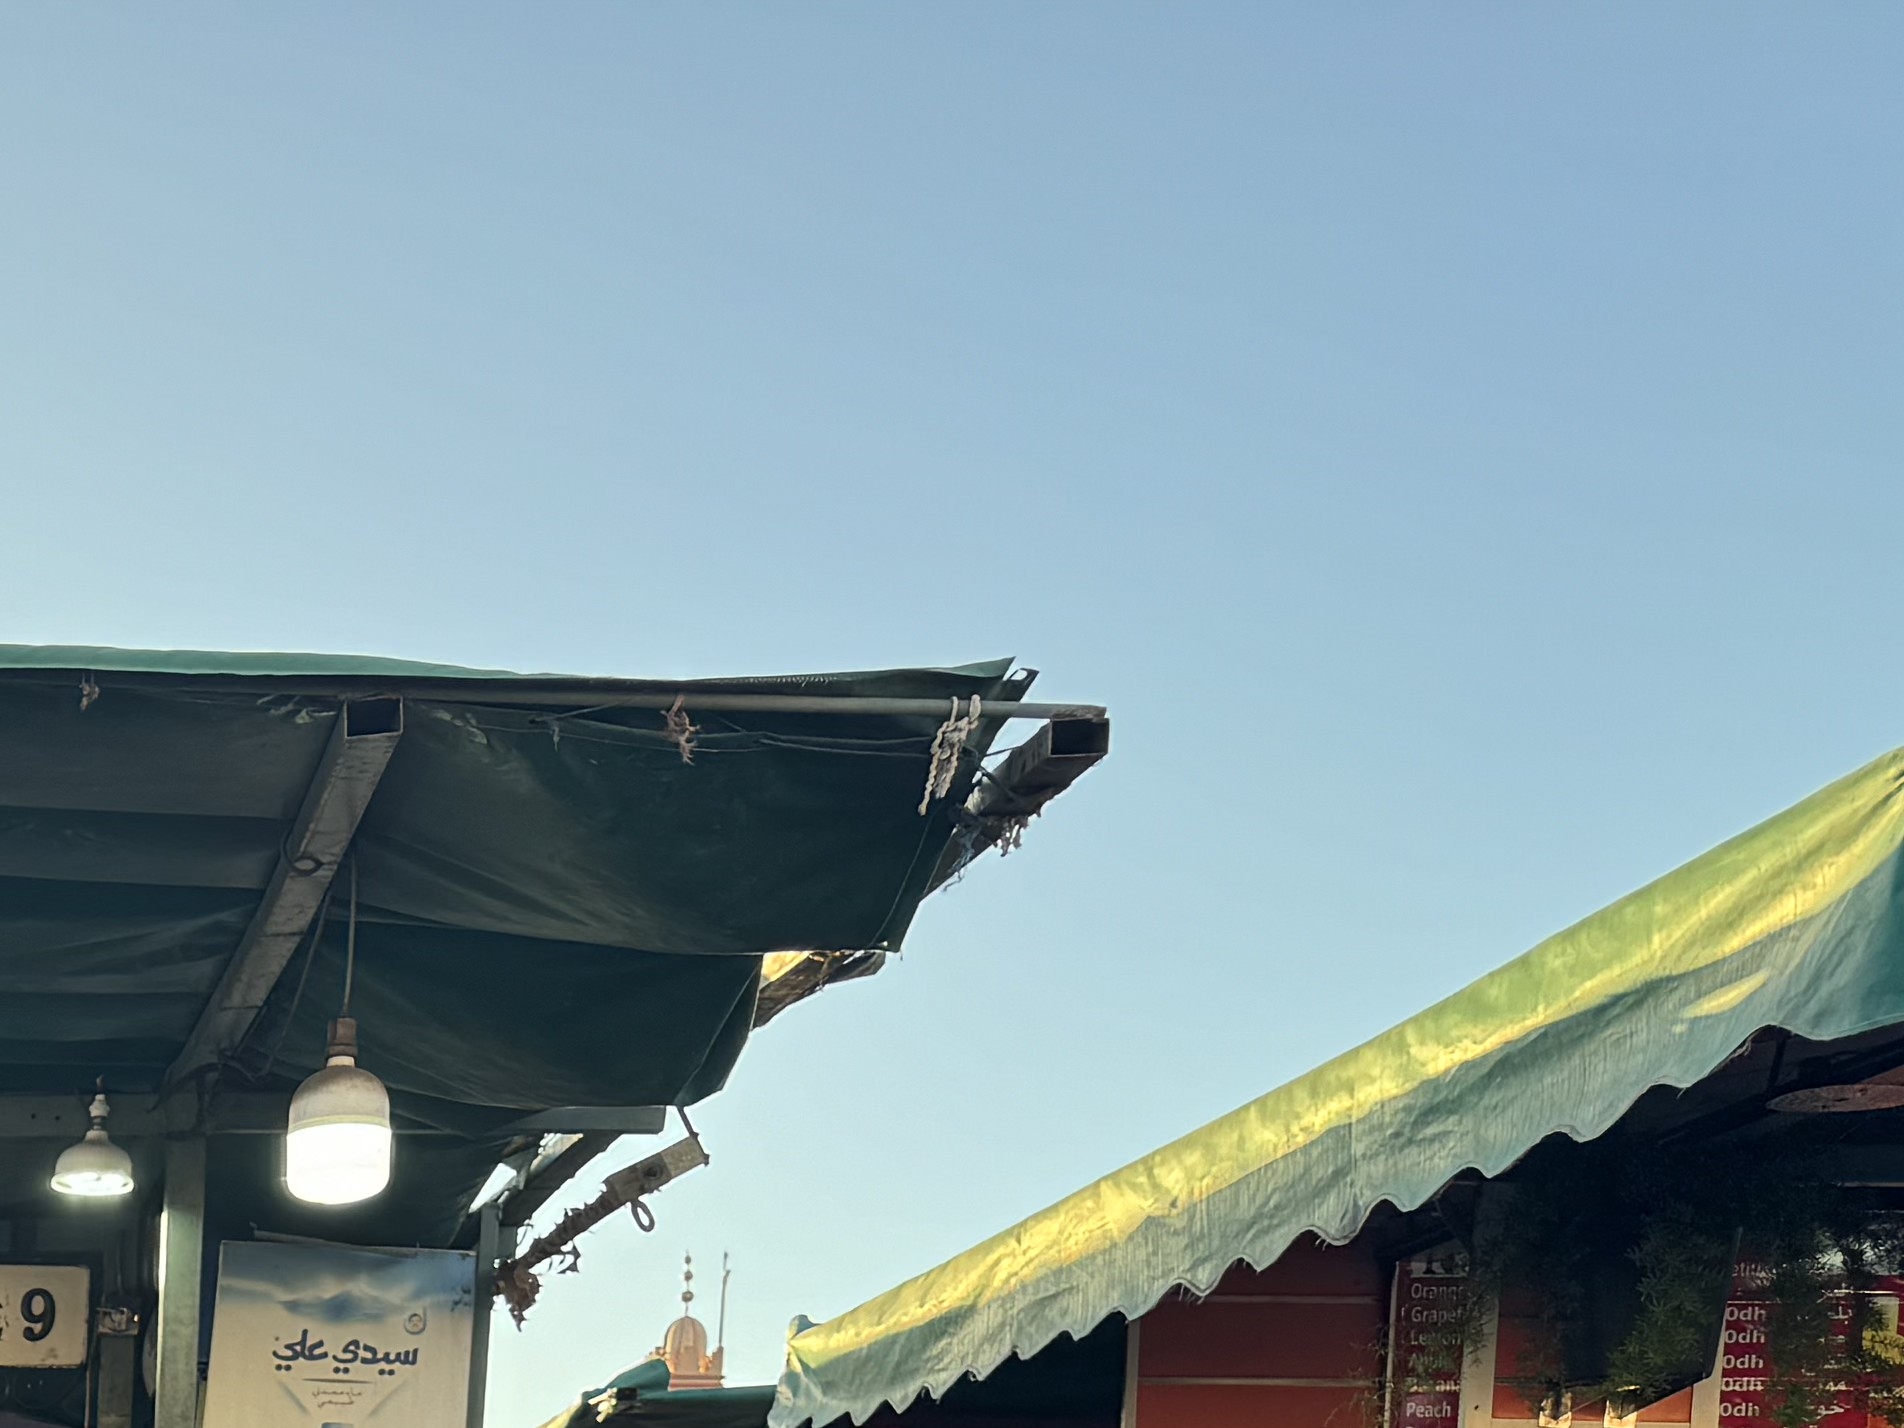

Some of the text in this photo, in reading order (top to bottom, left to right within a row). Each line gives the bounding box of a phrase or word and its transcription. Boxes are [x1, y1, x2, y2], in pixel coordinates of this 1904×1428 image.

[1725, 1306, 1766, 1321] 0dh
[1724, 1329, 1765, 1344] 0dh
[272, 1329, 419, 1376] سيدي علي
[1723, 1354, 1763, 1369] 0dh
[1722, 1377, 1764, 1391] 0dh
[1406, 1402, 1759, 1417] Peach 0dh
